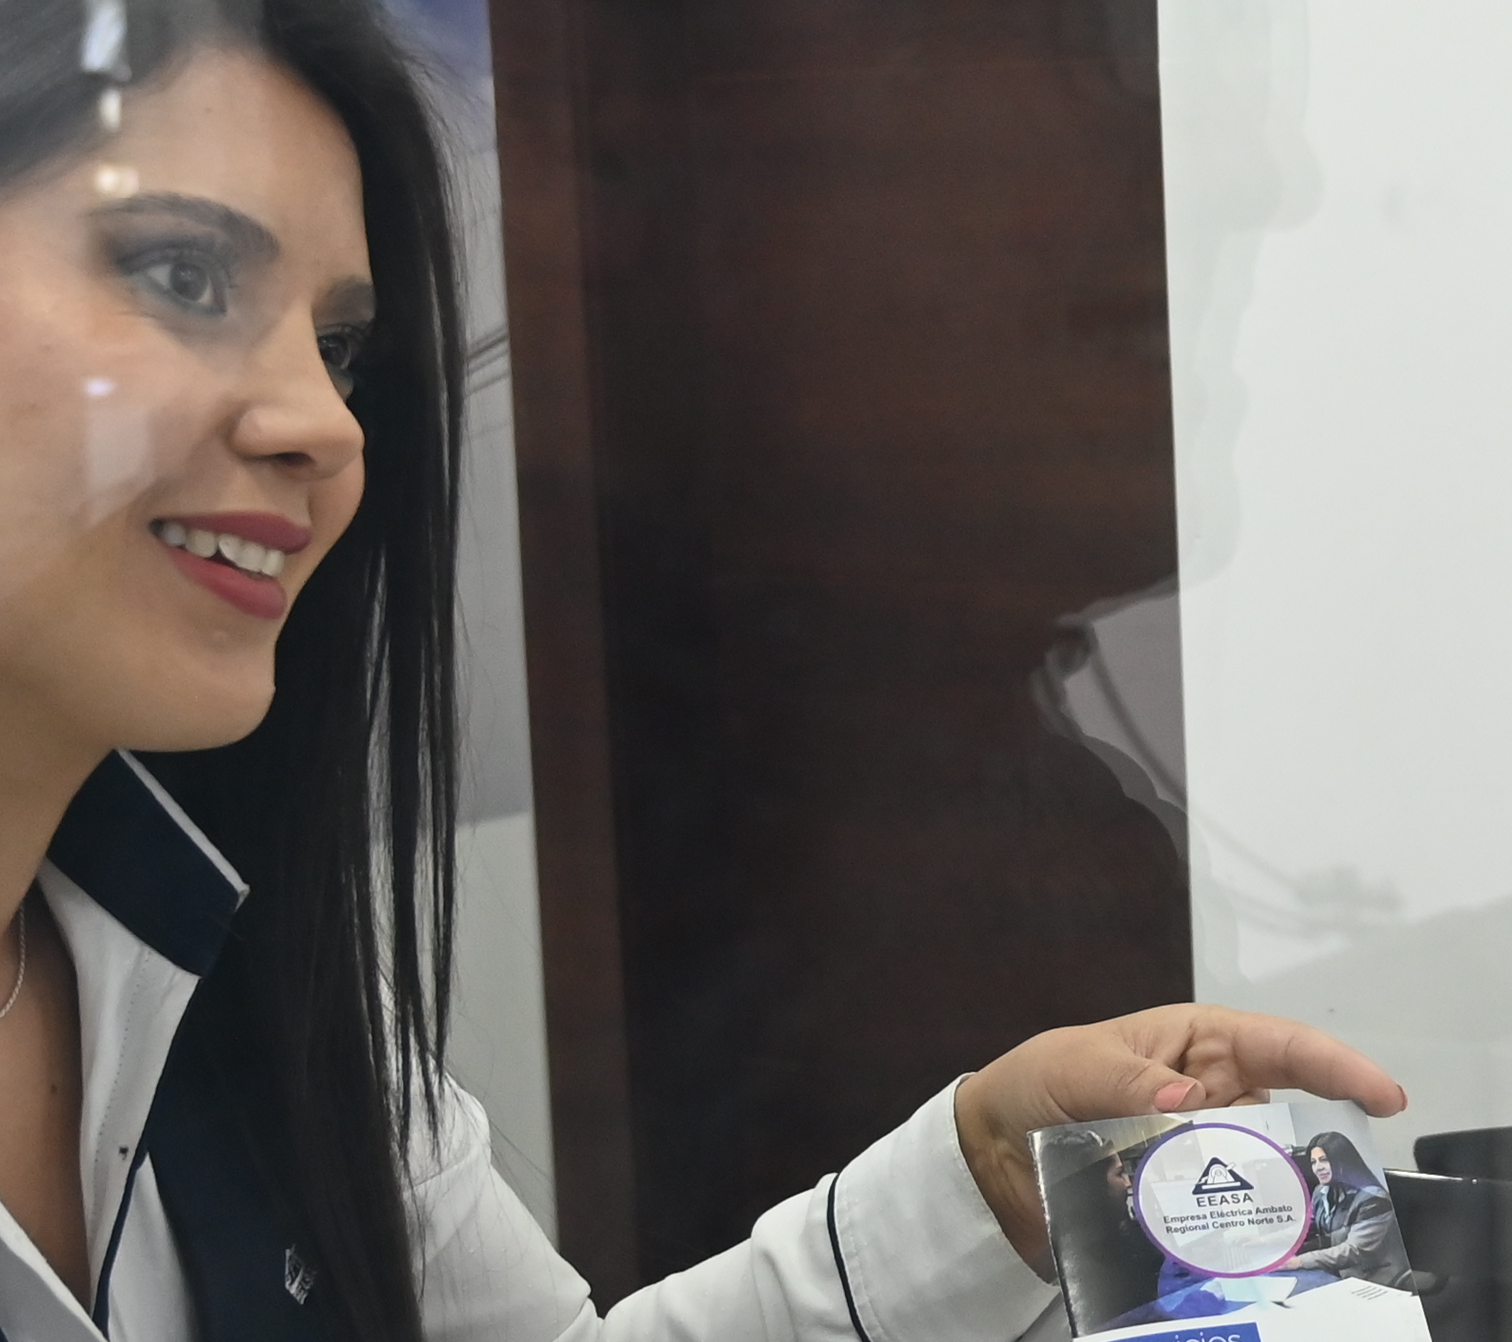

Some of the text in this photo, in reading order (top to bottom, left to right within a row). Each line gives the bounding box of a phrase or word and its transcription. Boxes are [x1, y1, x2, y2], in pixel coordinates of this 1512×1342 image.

[1196, 1192, 1254, 1208] EEASA
[1163, 1204, 1293, 1224] Empresa Eléctrica Ambato
[1165, 1214, 1296, 1234] Regional Centro Norte S.A.
